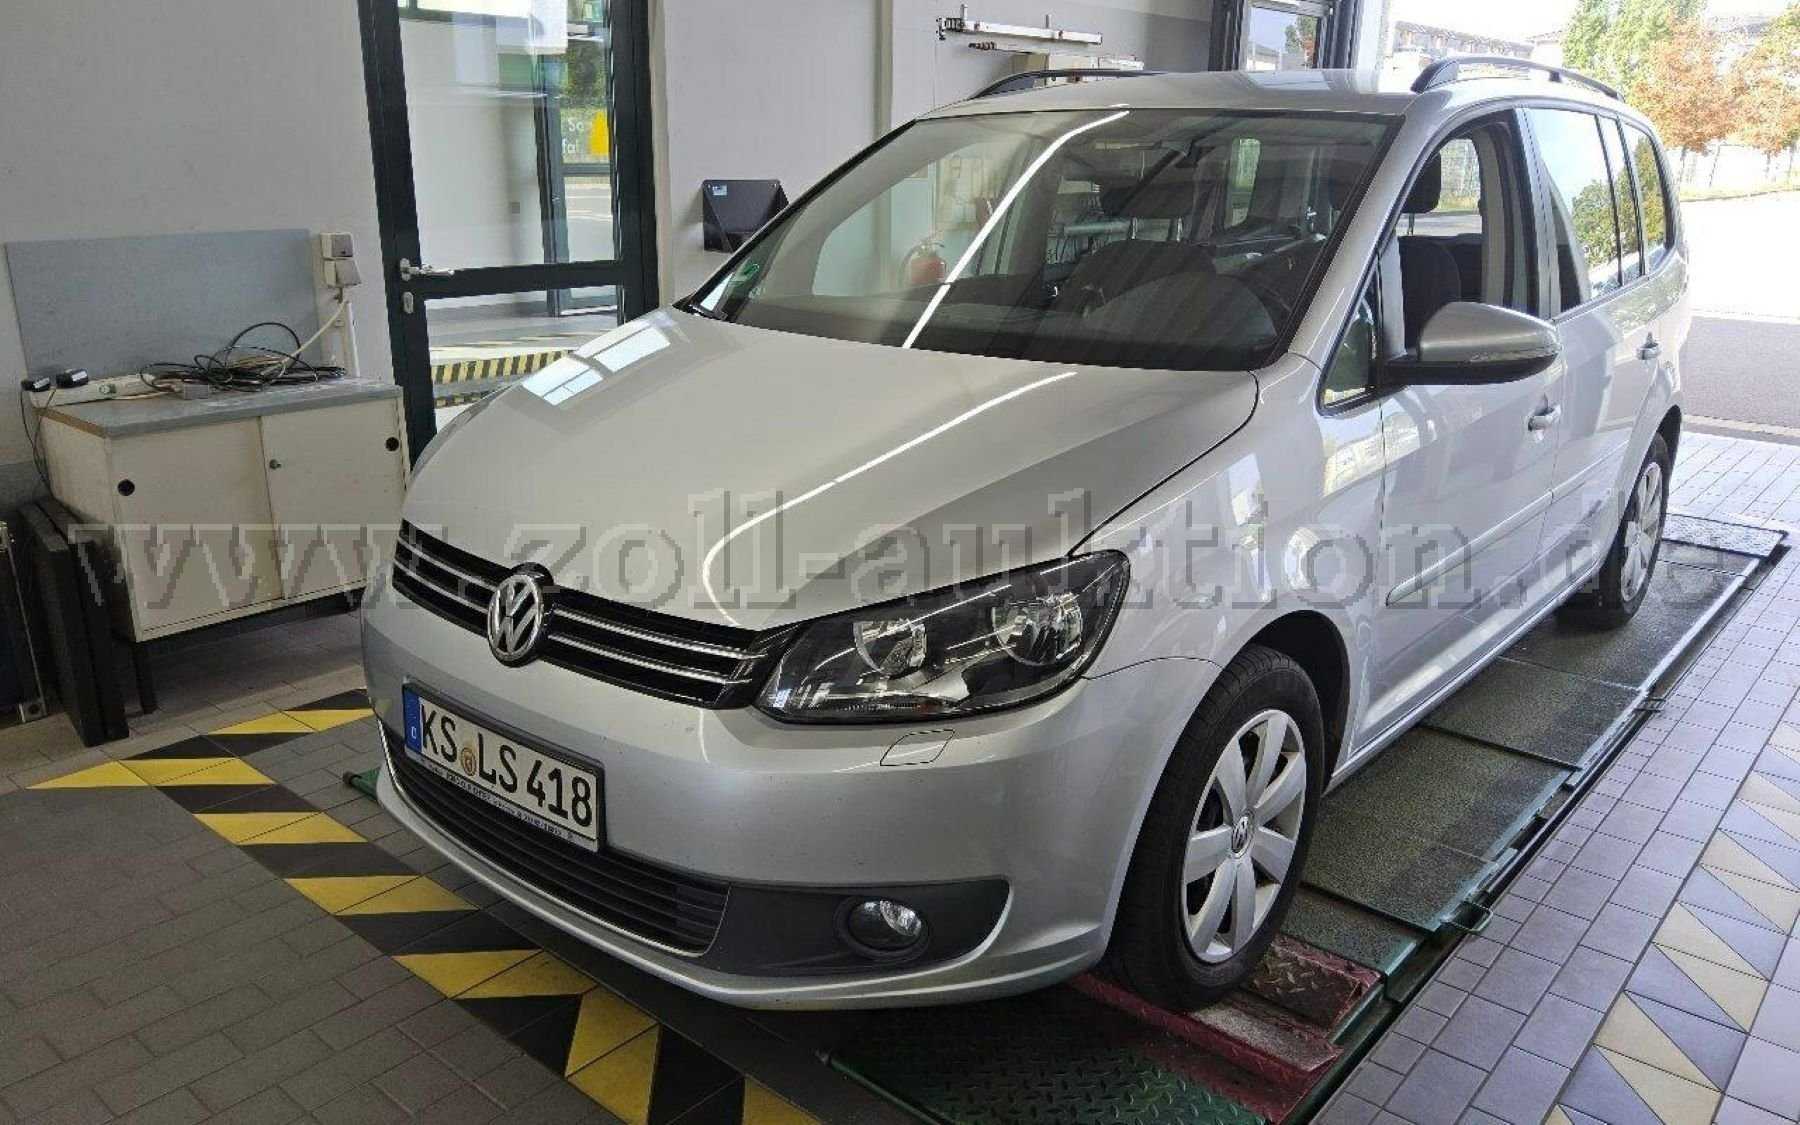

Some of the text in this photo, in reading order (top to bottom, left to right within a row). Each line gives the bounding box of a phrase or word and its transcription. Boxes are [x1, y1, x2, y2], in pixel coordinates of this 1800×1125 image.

[422, 704, 457, 762] KS
[478, 733, 517, 793] LS
[527, 760, 592, 826] 418
